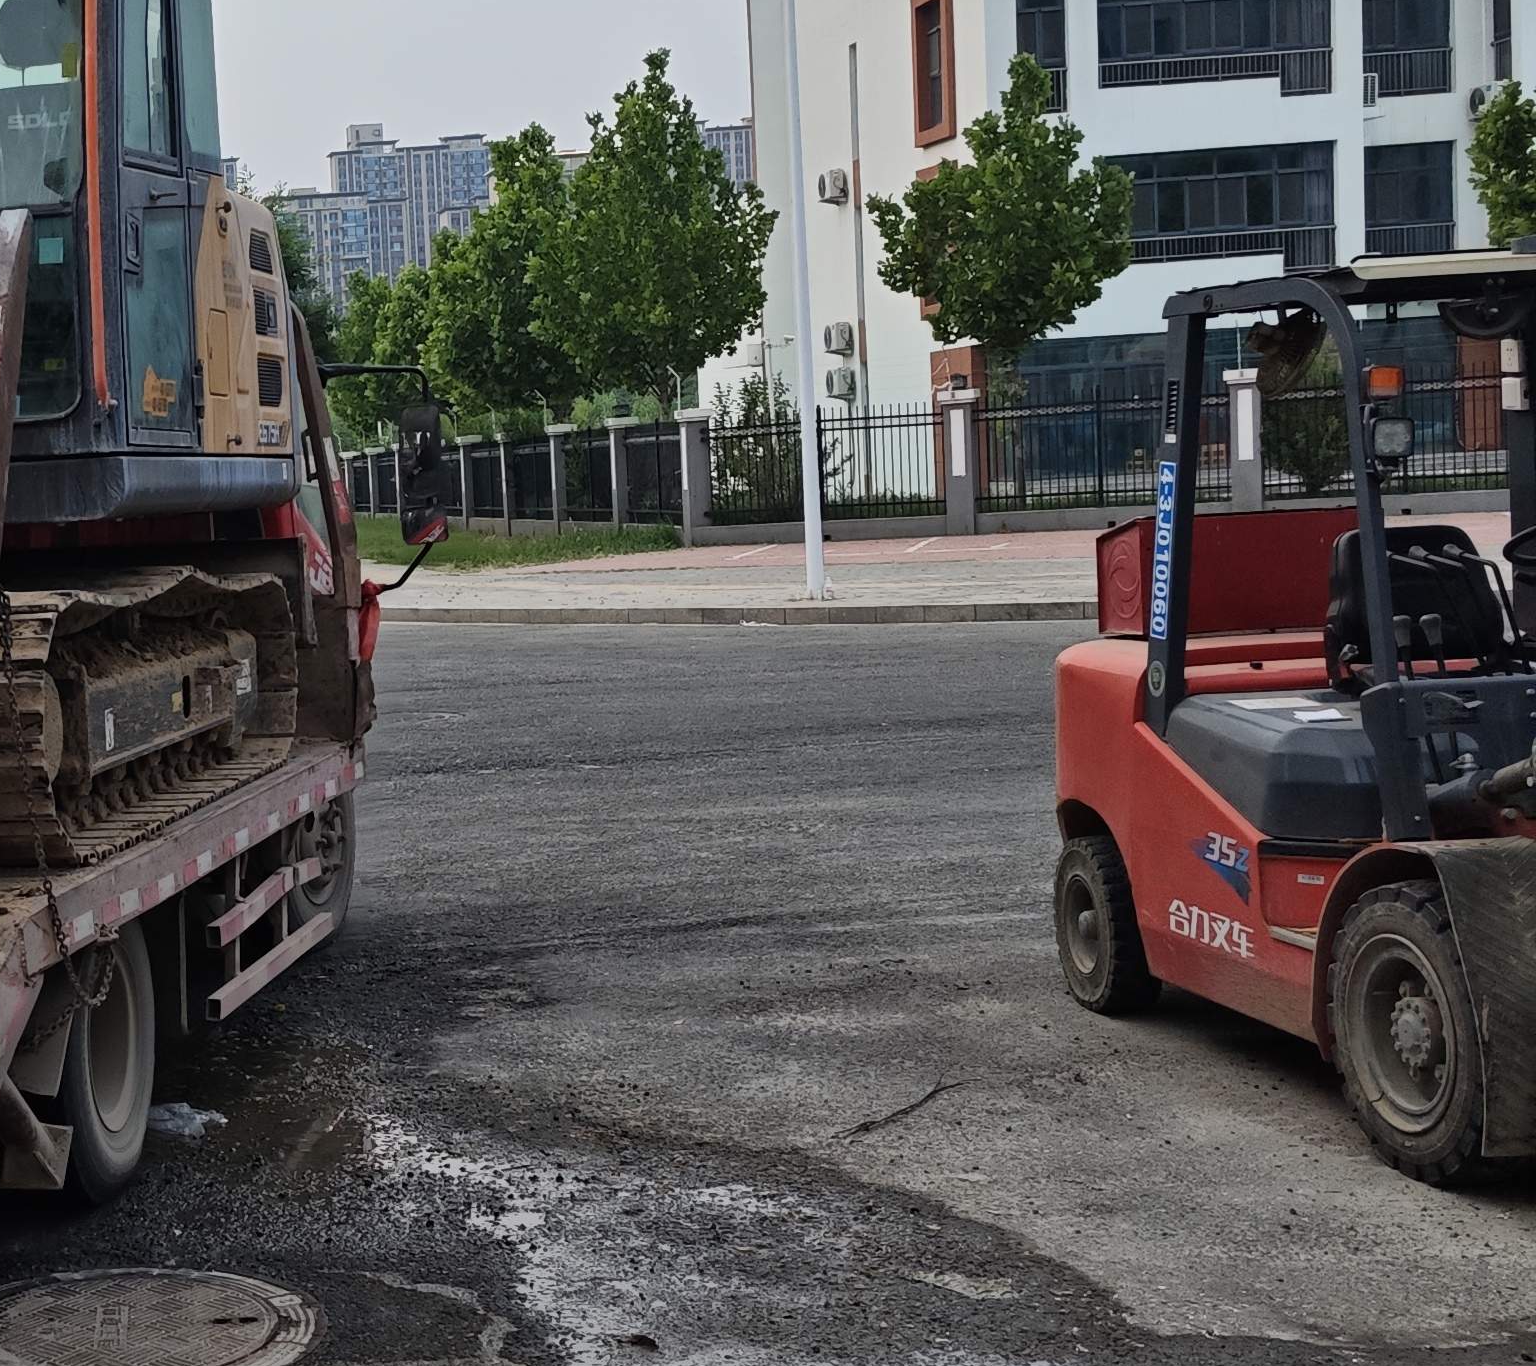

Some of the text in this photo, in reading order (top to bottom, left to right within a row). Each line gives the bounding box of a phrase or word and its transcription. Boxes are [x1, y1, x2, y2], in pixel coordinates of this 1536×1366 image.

[1152, 467, 1173, 633] 4-3J010060
[1168, 899, 1256, 958] 合力叉车
